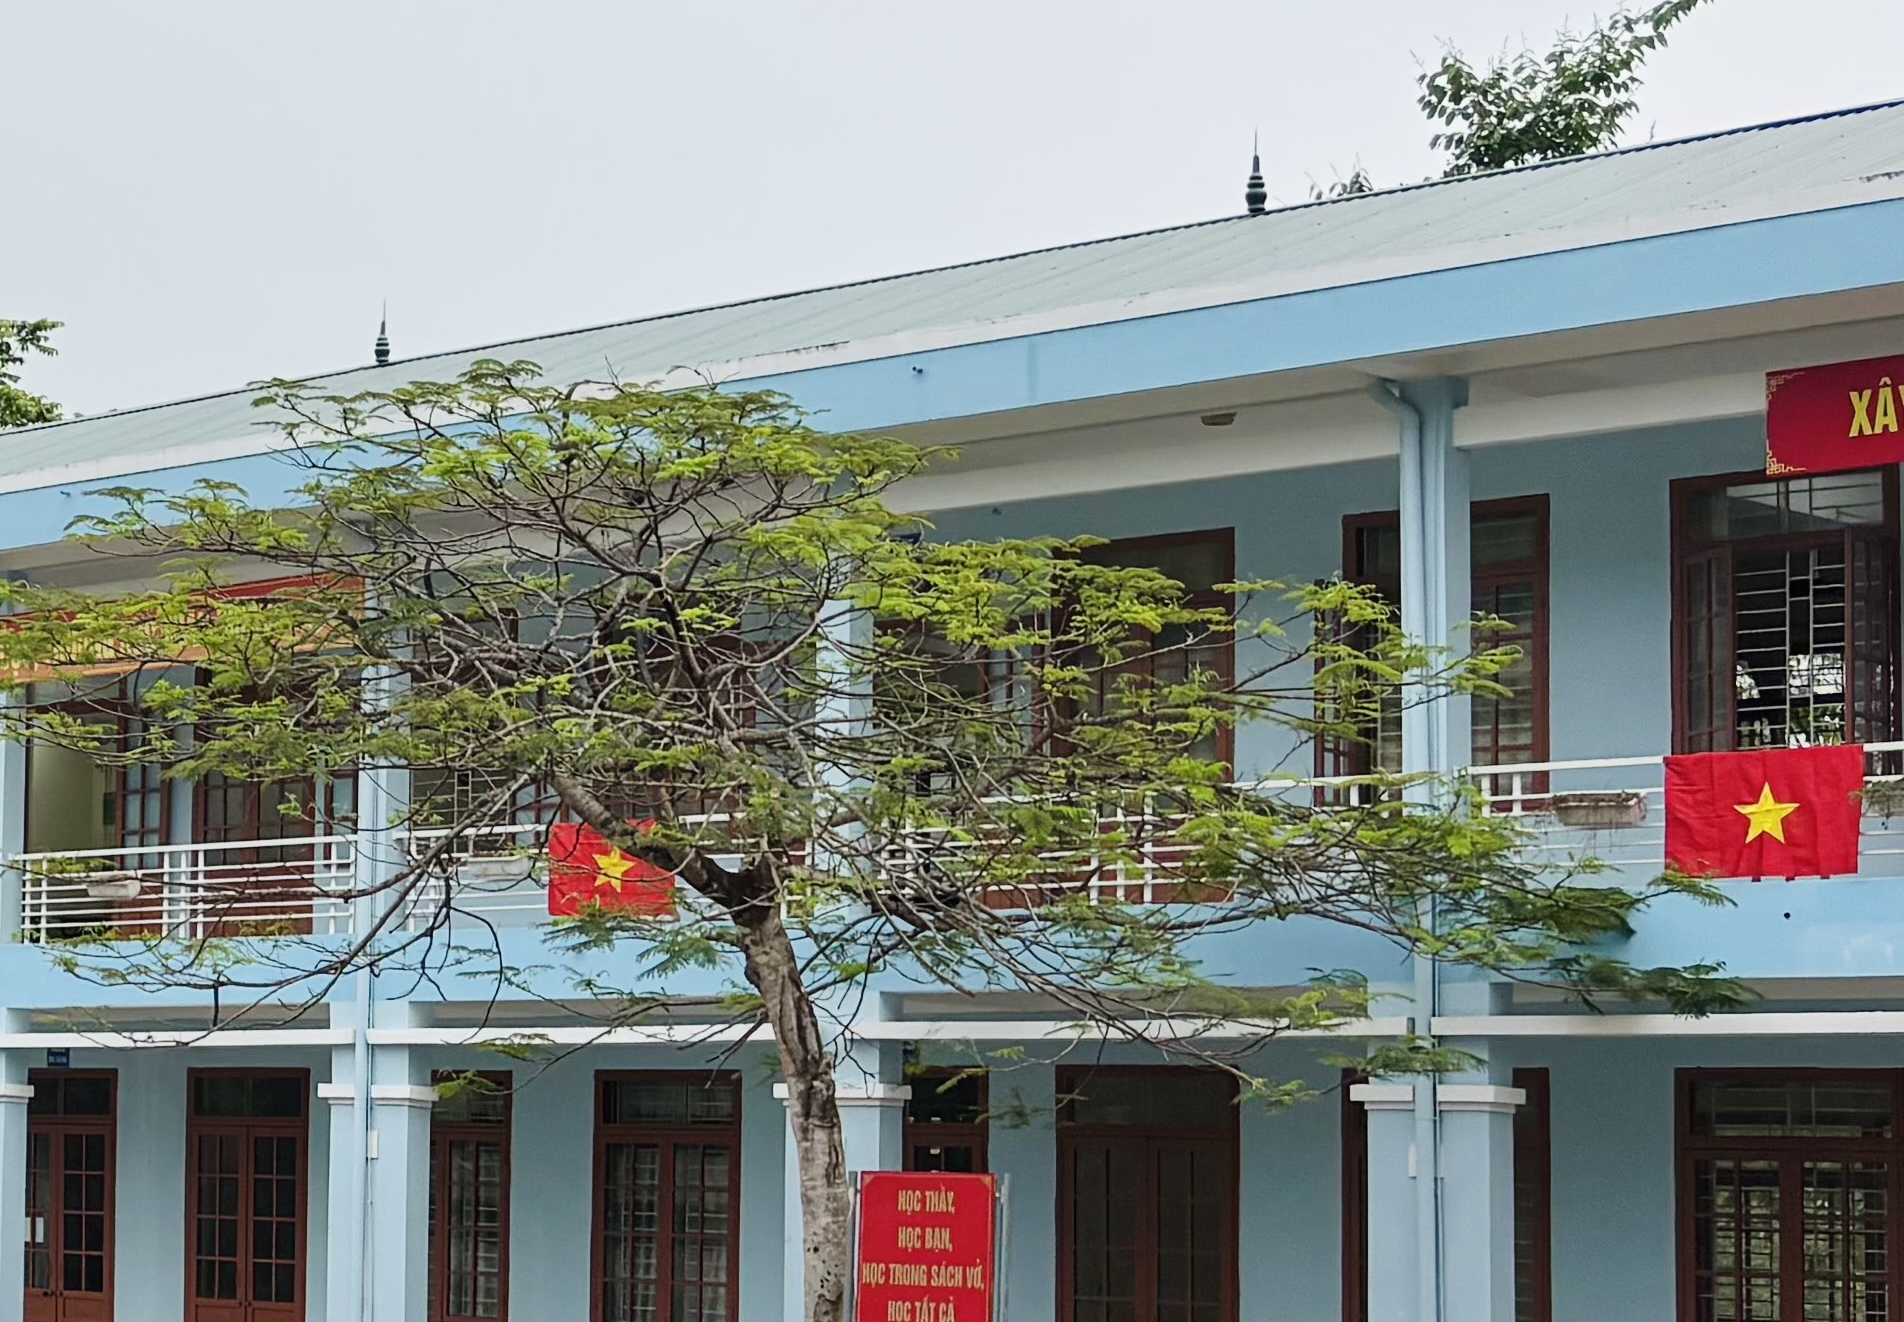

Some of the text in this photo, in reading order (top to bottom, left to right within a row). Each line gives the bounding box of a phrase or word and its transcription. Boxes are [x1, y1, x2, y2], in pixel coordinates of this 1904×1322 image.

[1848, 376, 1904, 438] XÂ
[897, 1190, 921, 1215] HỌC
[898, 1227, 952, 1253] HỌC BẠN,
[862, 1263, 885, 1288] HỌC
[889, 1263, 927, 1287] TRONG
[931, 1260, 963, 1288] SÁCH
